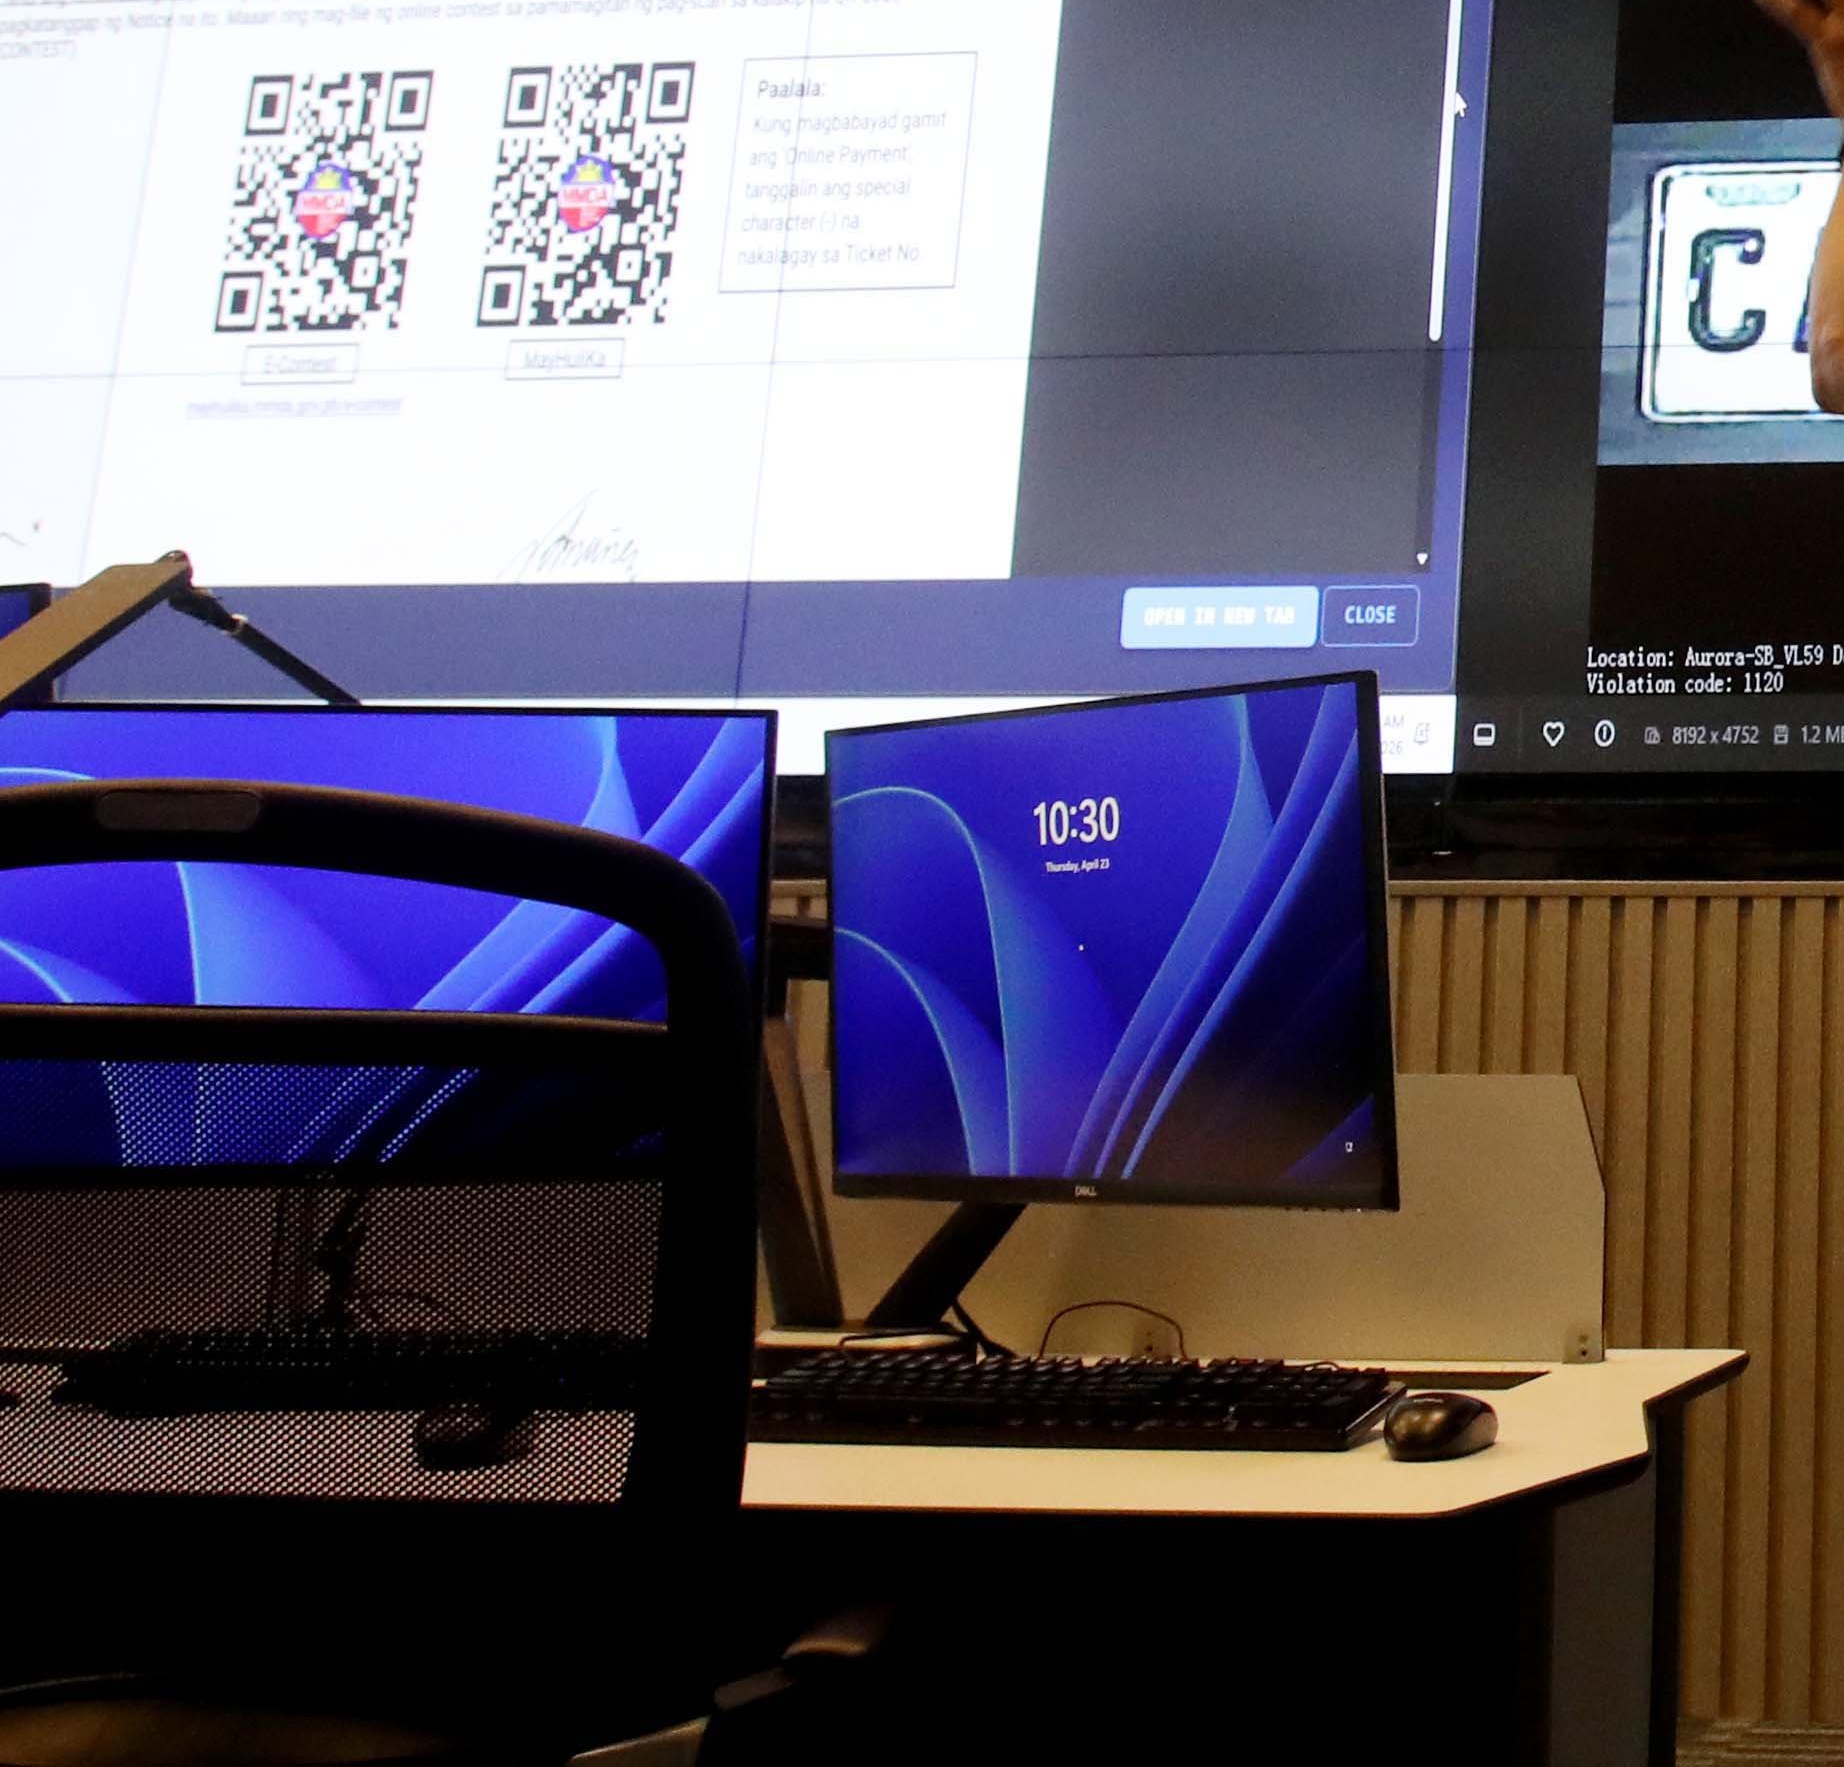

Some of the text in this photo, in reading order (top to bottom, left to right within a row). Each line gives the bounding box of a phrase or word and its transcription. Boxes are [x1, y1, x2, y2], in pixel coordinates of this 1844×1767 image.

[757, 78, 826, 99] Paalala:
[753, 111, 948, 137] Kung magbabayad gamit
[750, 150, 777, 169] ang
[745, 177, 912, 204] tanggalin ang special
[741, 214, 816, 233] character
[841, 213, 860, 230] na
[737, 243, 893, 269] nakalagay sa Ticket
[1143, 606, 1186, 626] OPEN
[1344, 605, 1397, 625] CLOSE
[1587, 646, 1674, 669] Location:
[1685, 646, 1824, 670] Aurora-SB_VL59
[1587, 672, 1783, 696] Violation code: 1120
[1672, 726, 1760, 744] 8192 x 4752
[1801, 726, 1823, 744] 1.2
[1033, 795, 1120, 847] 10:30
[1046, 858, 1110, 874] Thursday, April 23
[1075, 1185, 1097, 1197] DELL
